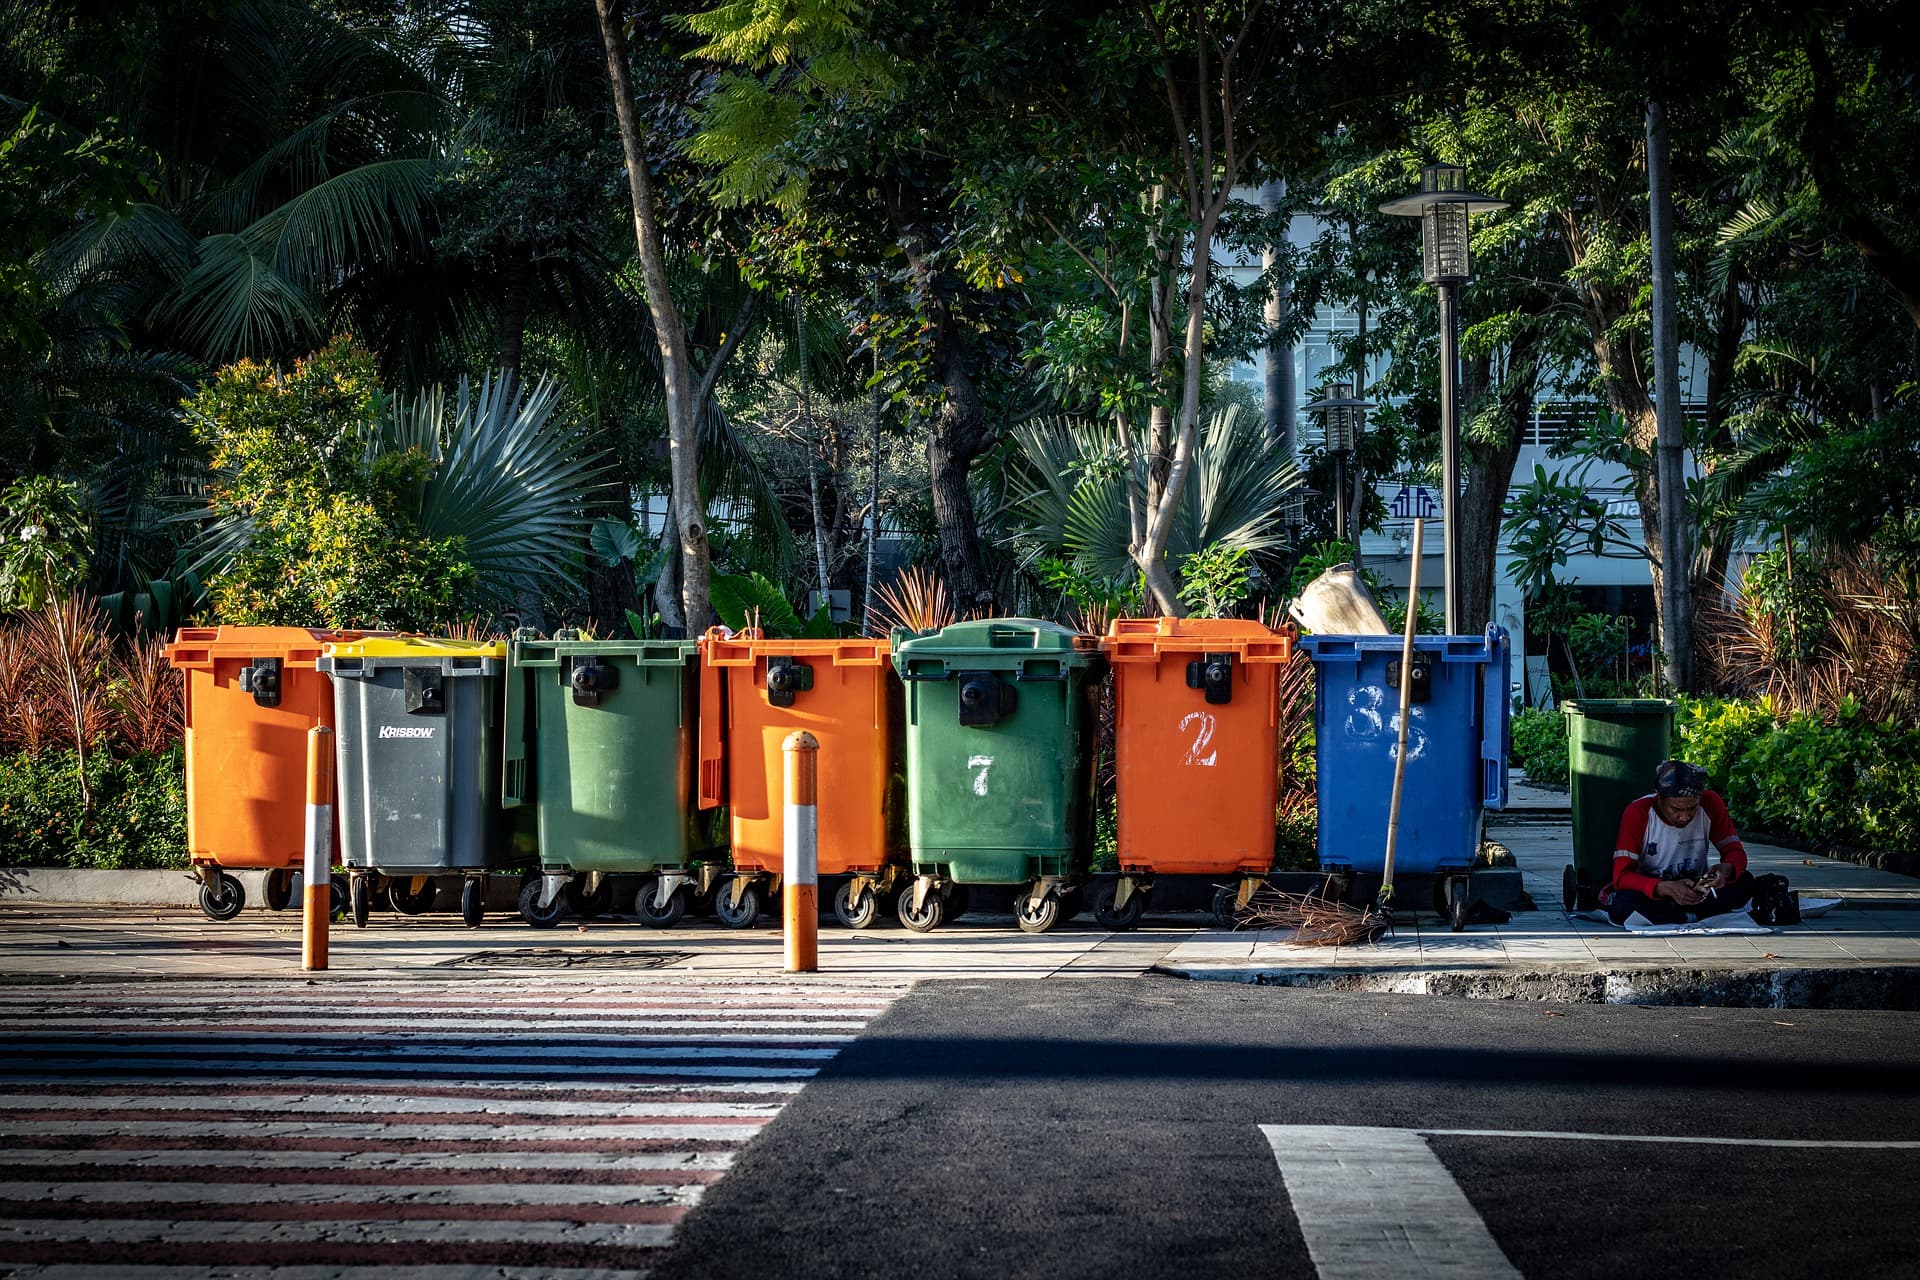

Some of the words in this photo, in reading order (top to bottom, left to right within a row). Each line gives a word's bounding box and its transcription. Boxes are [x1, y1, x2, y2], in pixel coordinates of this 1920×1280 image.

[378, 725, 434, 739] KRISBOW
[1179, 711, 1217, 767] 2
[967, 754, 995, 796] 7
